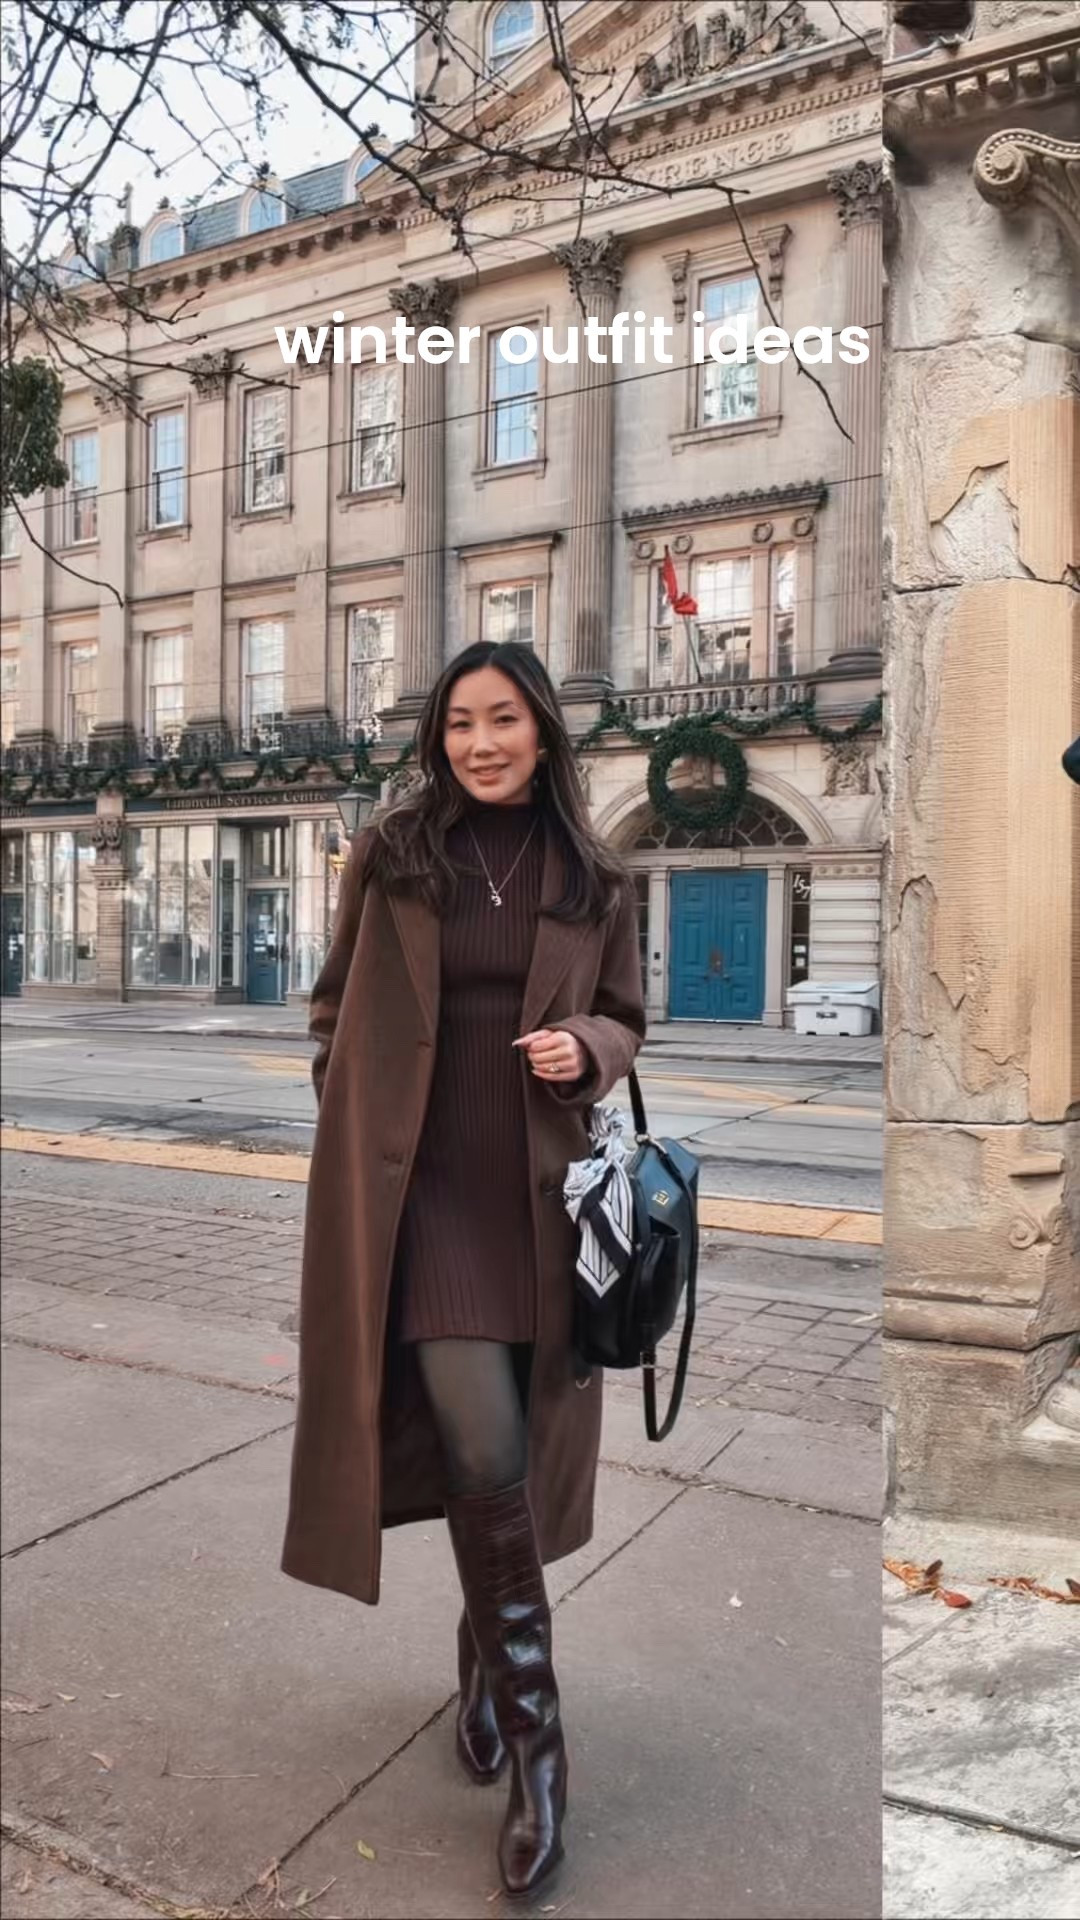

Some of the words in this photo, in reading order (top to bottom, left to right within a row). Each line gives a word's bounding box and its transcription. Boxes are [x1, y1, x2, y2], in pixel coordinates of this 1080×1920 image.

[227, 793, 277, 806] Services
[282, 788, 328, 802] Centre
[793, 874, 811, 898] 157
